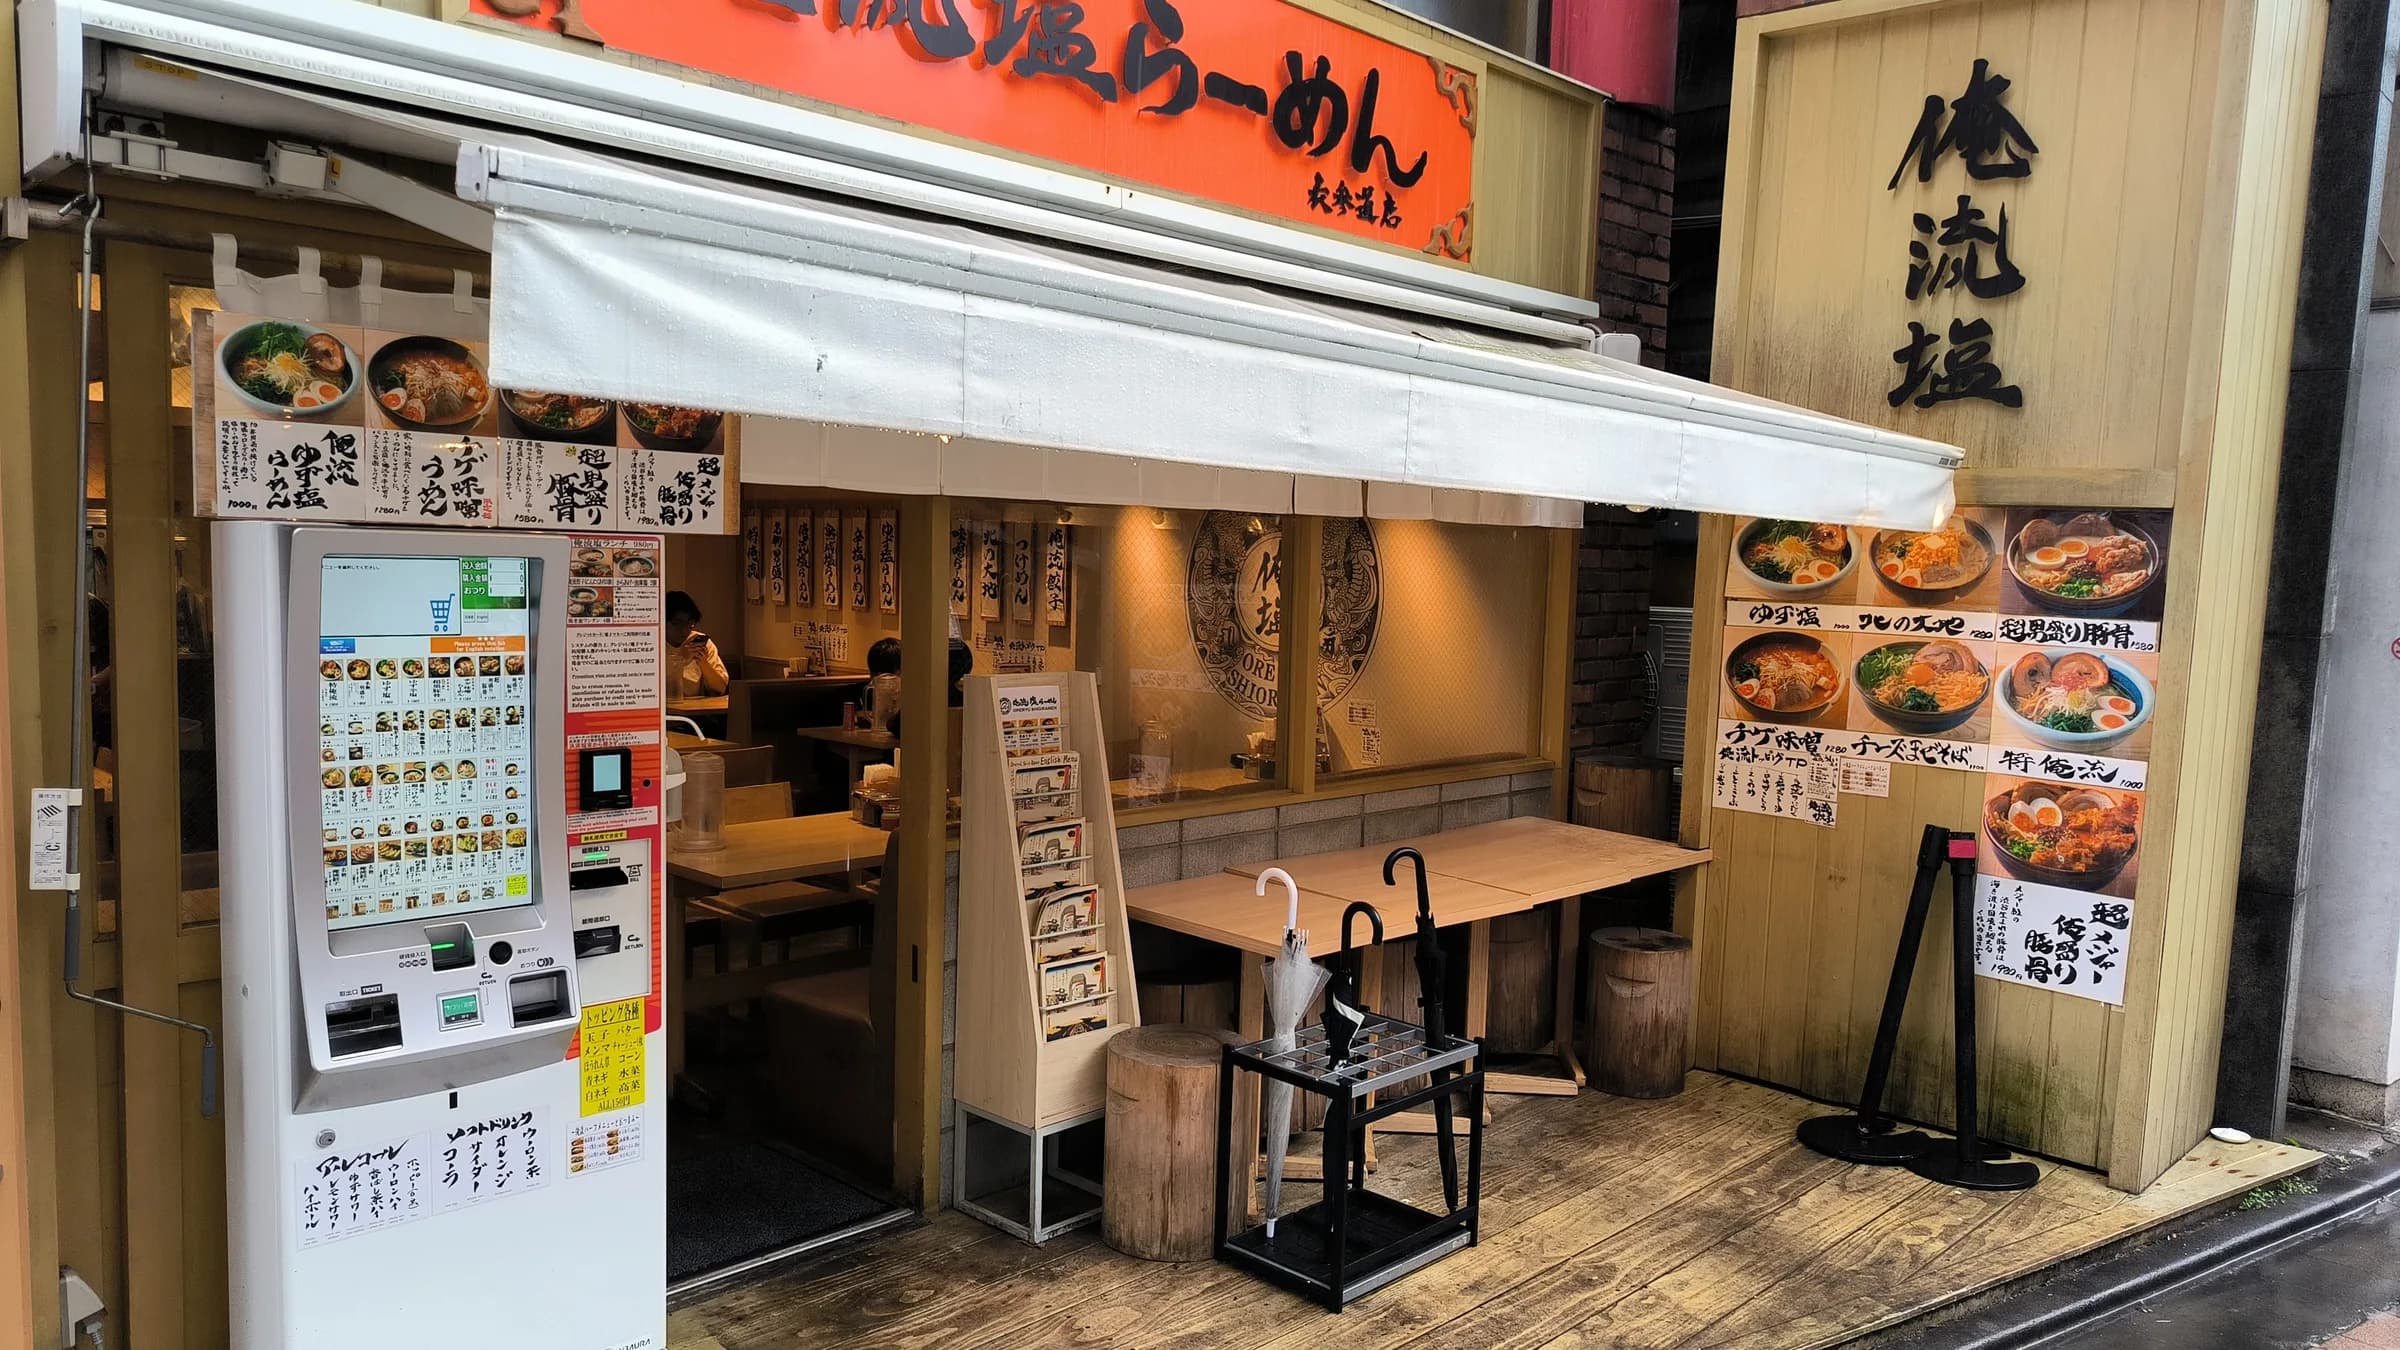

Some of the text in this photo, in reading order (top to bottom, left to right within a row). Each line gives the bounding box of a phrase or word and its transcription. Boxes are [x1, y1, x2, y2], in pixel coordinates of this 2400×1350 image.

[144, 61, 185, 75] STOP
[755, 0, 1428, 188] 塩らーめん
[1888, 58, 2039, 409] 俺流塩
[291, 442, 329, 509] ゆず塩
[321, 430, 360, 486] 俺流
[265, 449, 292, 509] らーめん
[544, 472, 580, 523] 豚骨
[577, 448, 612, 525] 超男盛り
[697, 456, 720, 521] 超メジャー
[227, 499, 258, 511] 1000円
[658, 485, 678, 526] 豚骨
[464, 587, 485, 595] おつり
[1015, 540, 1029, 605] つけめん
[1749, 604, 1822, 628] ゆず塩
[1858, 613, 1966, 636] 北の大地
[1999, 618, 2154, 651] 超男盛り豚骨 1580
[1725, 722, 1848, 756] チゲ味噌 1280
[1851, 734, 1973, 766] チーズまぜそば
[1040, 755, 1061, 766] English
[1063, 754, 1078, 763] Menu
[1999, 750, 2143, 790] 特俺流 1000
[2025, 930, 2054, 984] 豚骨
[2086, 902, 2130, 985] 超メジャー
[1990, 964, 2023, 980] 1980円
[585, 1044, 610, 1057] メンマ
[619, 1051, 640, 1063] コーン
[619, 1065, 640, 1078] 水菜
[586, 1087, 608, 1102] 白ネギ
[446, 1111, 533, 1144] ソフトドリンク
[316, 1138, 409, 1178] アルコール
[442, 1148, 459, 1189] コーラ
[470, 1141, 488, 1193] サイダー
[493, 1135, 514, 1188] オレンジ
[522, 1127, 541, 1180] ウーロン茶
[303, 1185, 321, 1230] ハイボール
[328, 1177, 340, 1229] レモンサワー
[349, 1172, 361, 1222] ゆずサワー
[388, 1163, 401, 1211] ウーロンハイ
